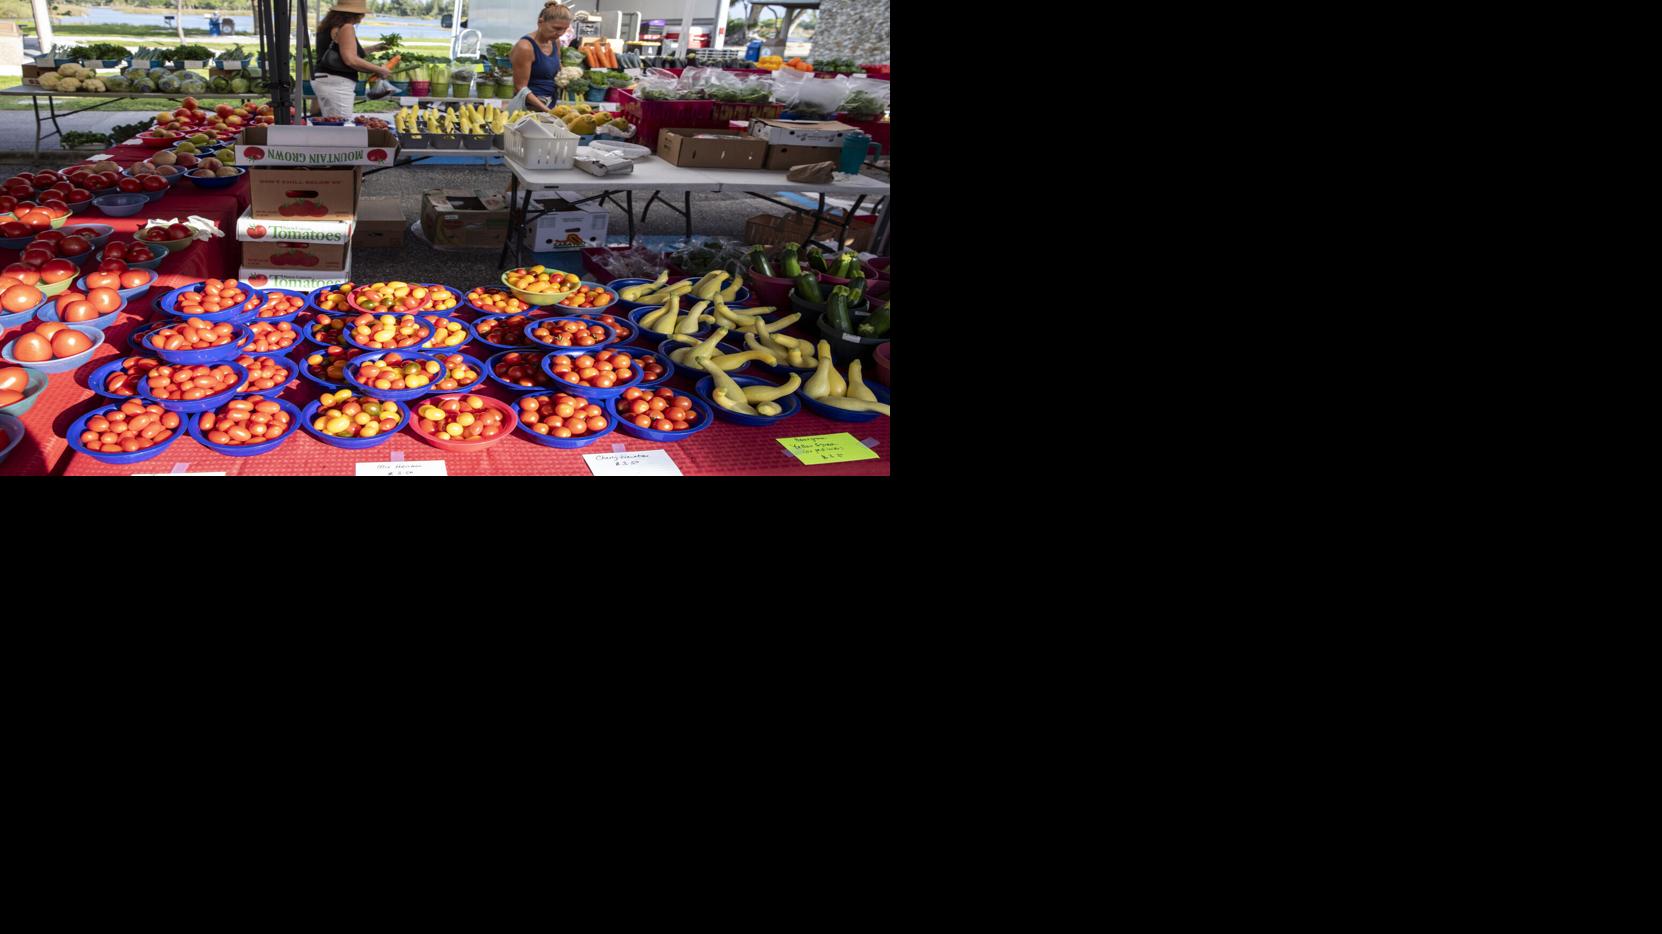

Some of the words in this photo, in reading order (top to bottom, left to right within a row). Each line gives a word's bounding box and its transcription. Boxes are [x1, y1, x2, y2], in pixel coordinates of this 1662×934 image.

[267, 148, 307, 163] GROWN
[309, 150, 364, 164] MOUNTAIN
[268, 225, 342, 242] Tomatoes
